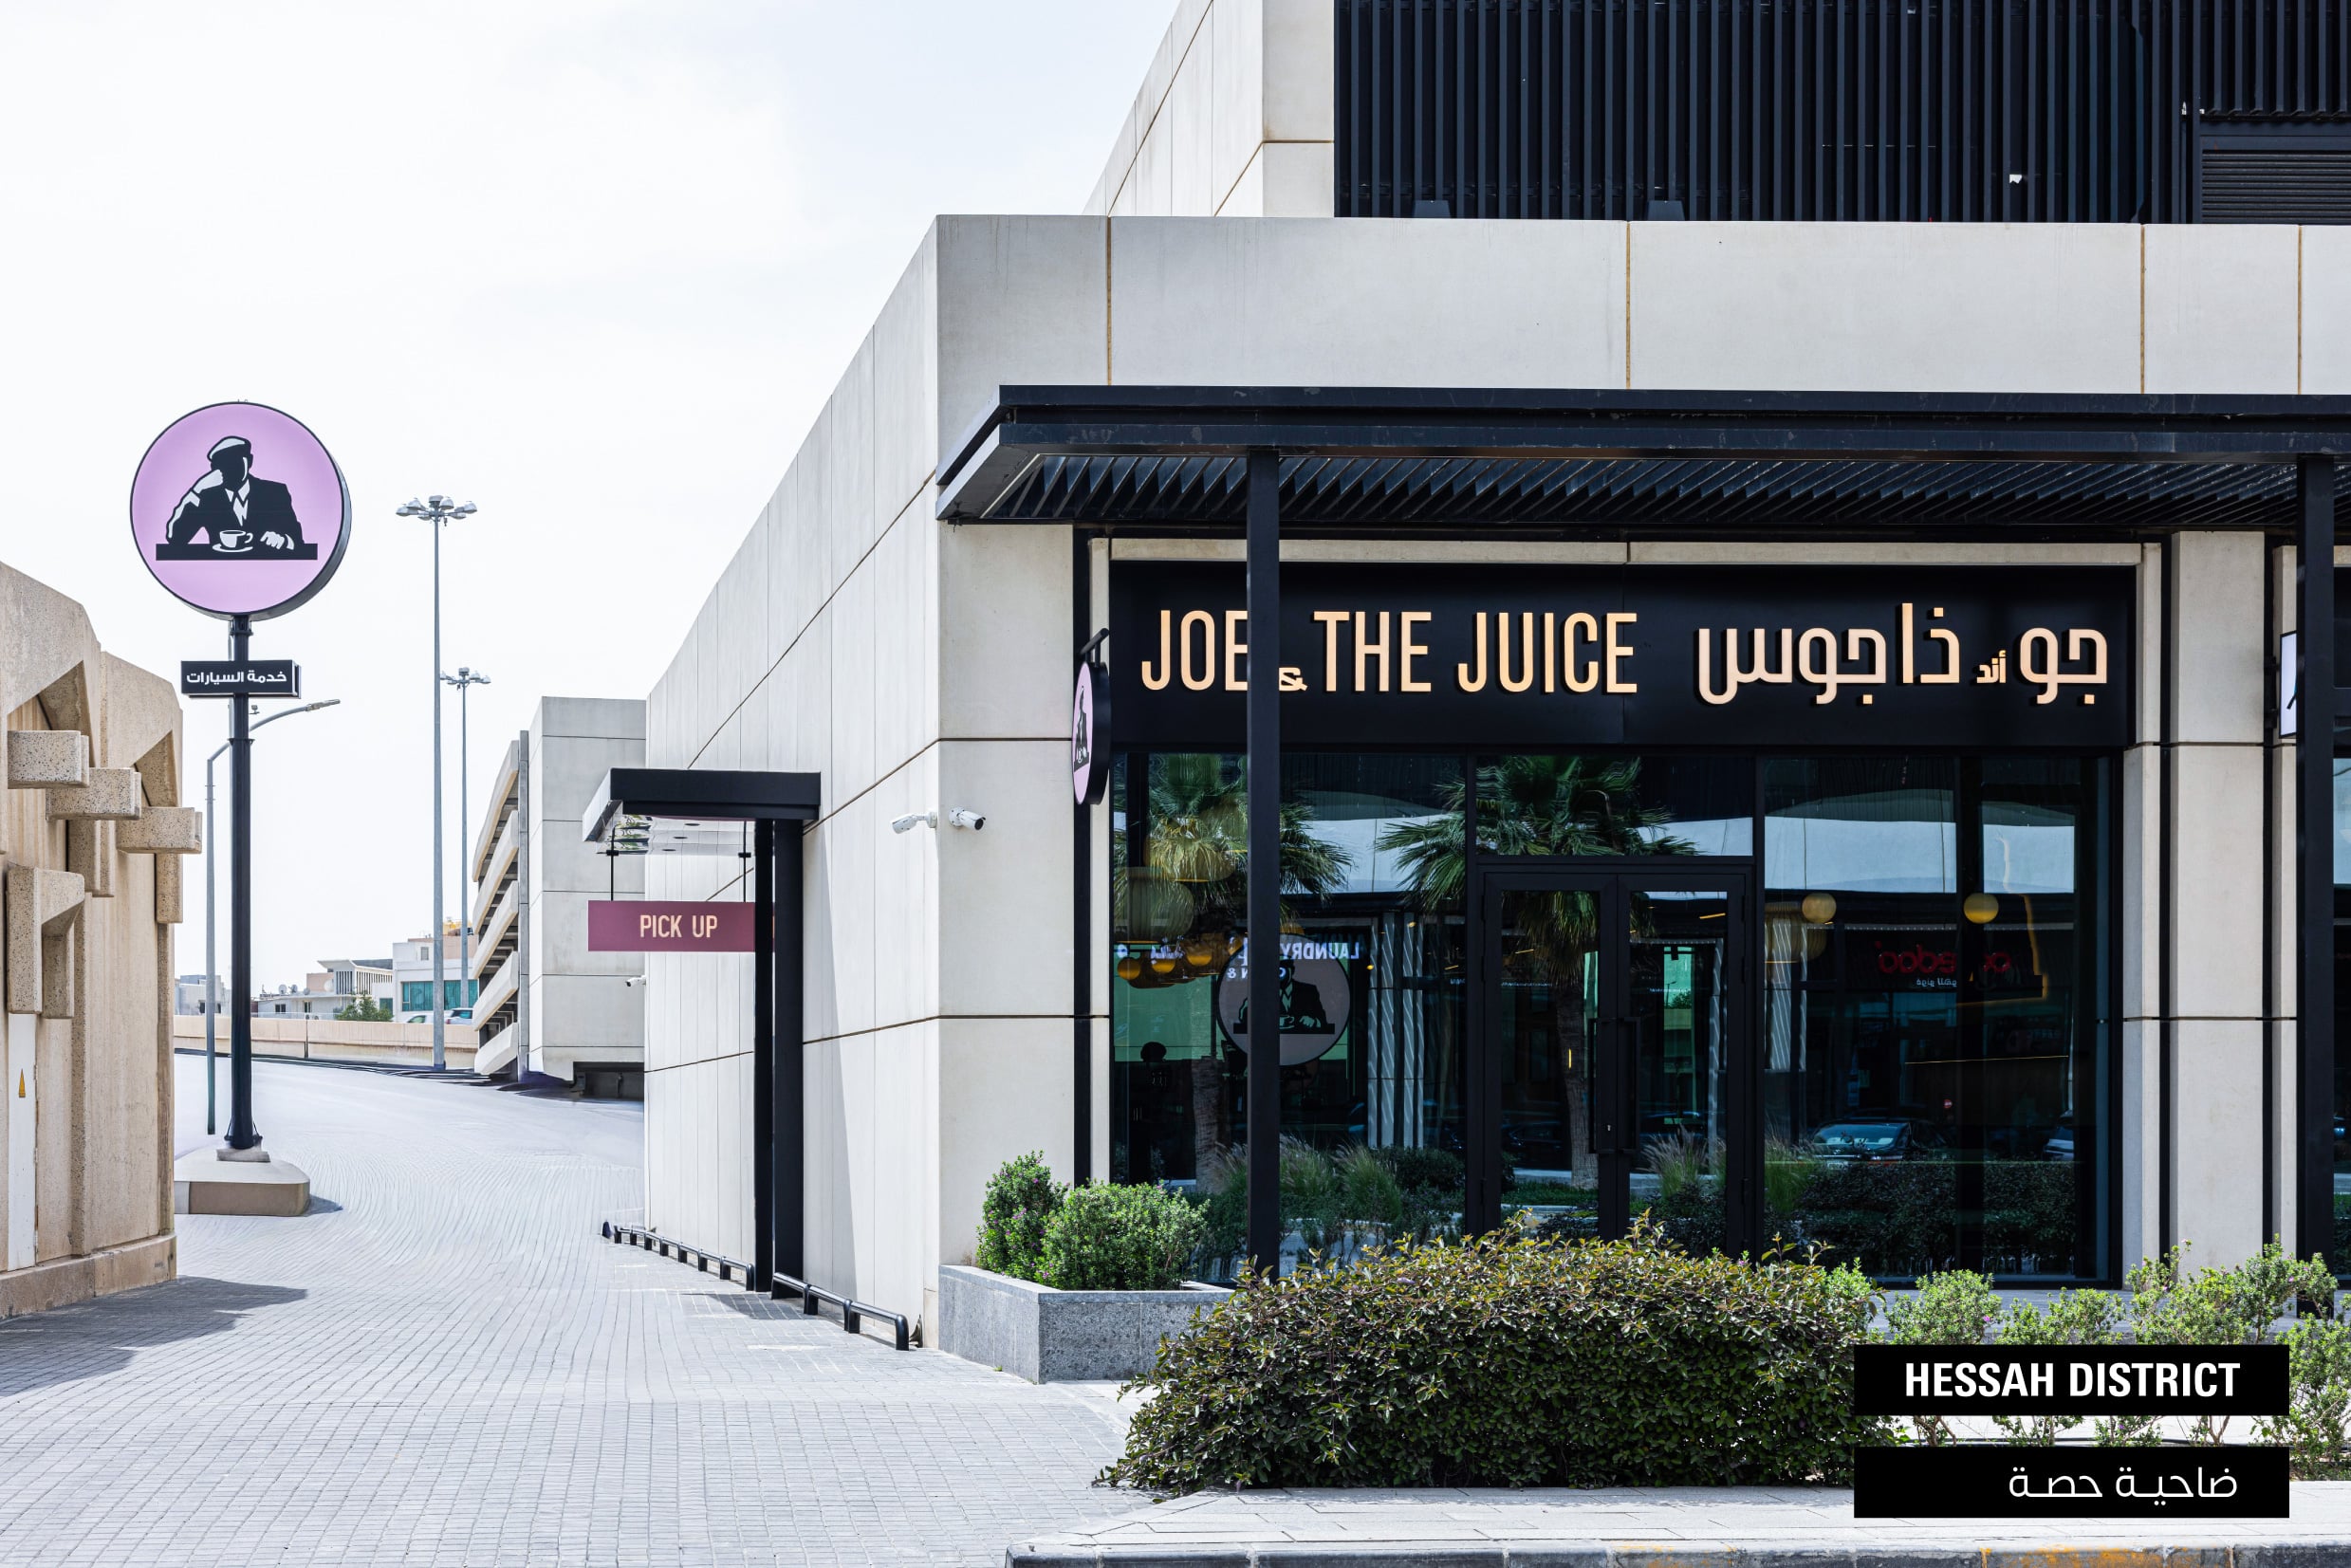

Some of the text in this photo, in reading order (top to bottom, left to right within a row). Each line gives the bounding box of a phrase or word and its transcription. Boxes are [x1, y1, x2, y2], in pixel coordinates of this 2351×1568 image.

[186, 670, 287, 686] خدمة السيارات
[1142, 609, 1638, 693] JOE & THE JUICE
[1698, 602, 2107, 705] جو أند ذا جوس
[639, 914, 718, 938] PICK UP
